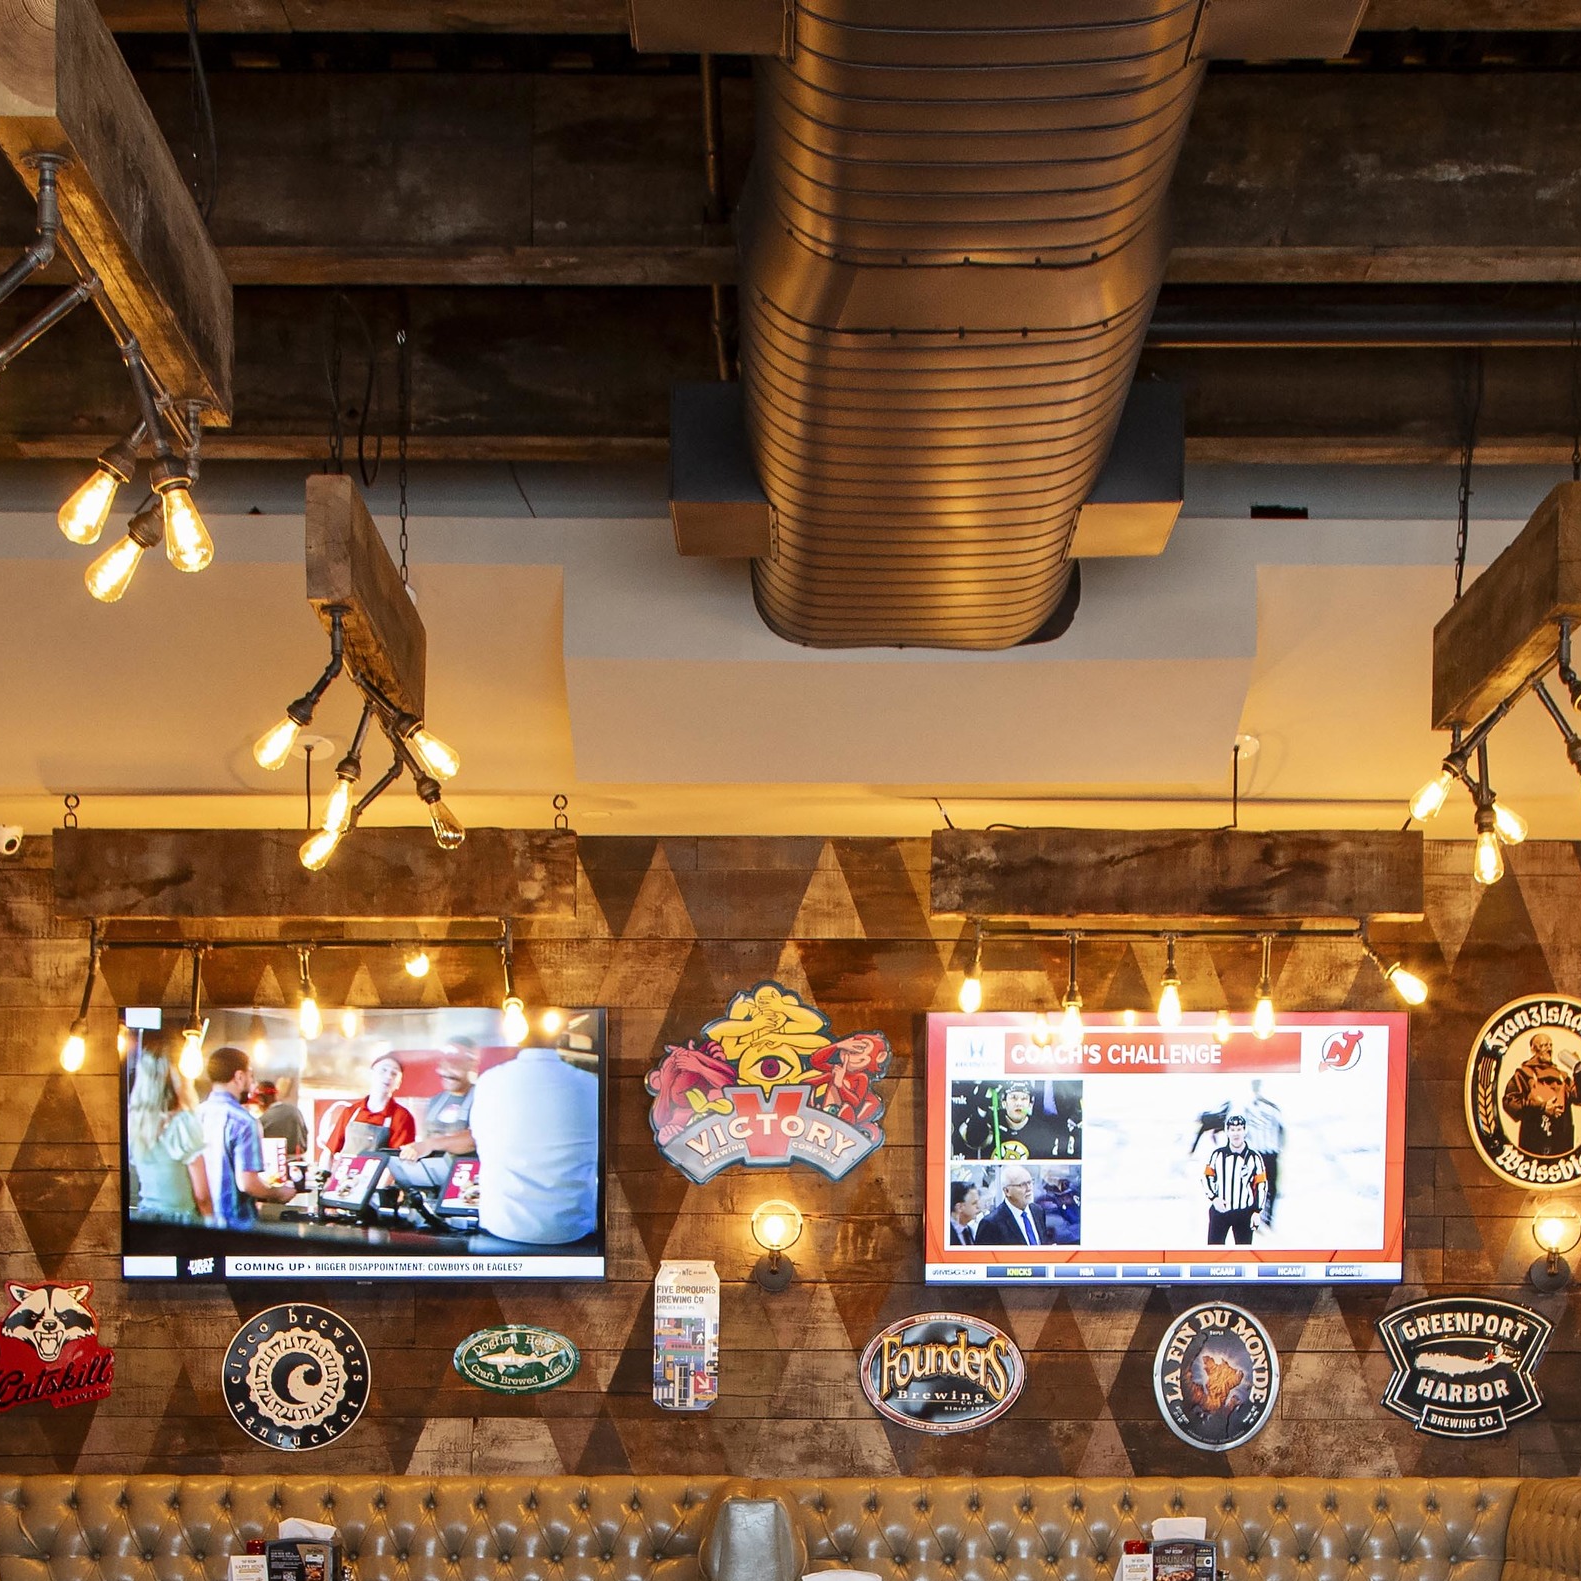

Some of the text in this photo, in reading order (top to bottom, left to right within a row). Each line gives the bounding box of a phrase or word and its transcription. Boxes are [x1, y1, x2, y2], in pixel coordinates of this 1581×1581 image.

[1011, 1044, 1222, 1065] COACH'S CHALLENGE
[685, 1113, 857, 1158] VICTORY
[703, 1140, 837, 1167] BREWING COMPANY
[235, 1262, 523, 1273] COMING UP BIGGER DISAPPOINTMENT: COWBOYS OR EAGLES?
[1007, 1267, 1032, 1276] KNICKS
[1079, 1267, 1094, 1276] NBA
[1147, 1267, 1161, 1276] NFL
[657, 1285, 717, 1295] FIVE BOROUGHS
[657, 1295, 692, 1304] BREWING
[1401, 1312, 1529, 1342] GREENPORT
[231, 1308, 363, 1384] cisco brewers
[472, 1333, 518, 1356] Dogfish
[879, 1330, 1008, 1401] Founders
[1164, 1309, 1269, 1404] LA FIN DU MONDE
[471, 1364, 565, 1385] Craft Brewed Ales
[897, 1390, 985, 1404] Brewing
[1417, 1377, 1511, 1403] HARBOR
[235, 1399, 359, 1446] nantucket
[1430, 1413, 1498, 1429] BREWING CO.
